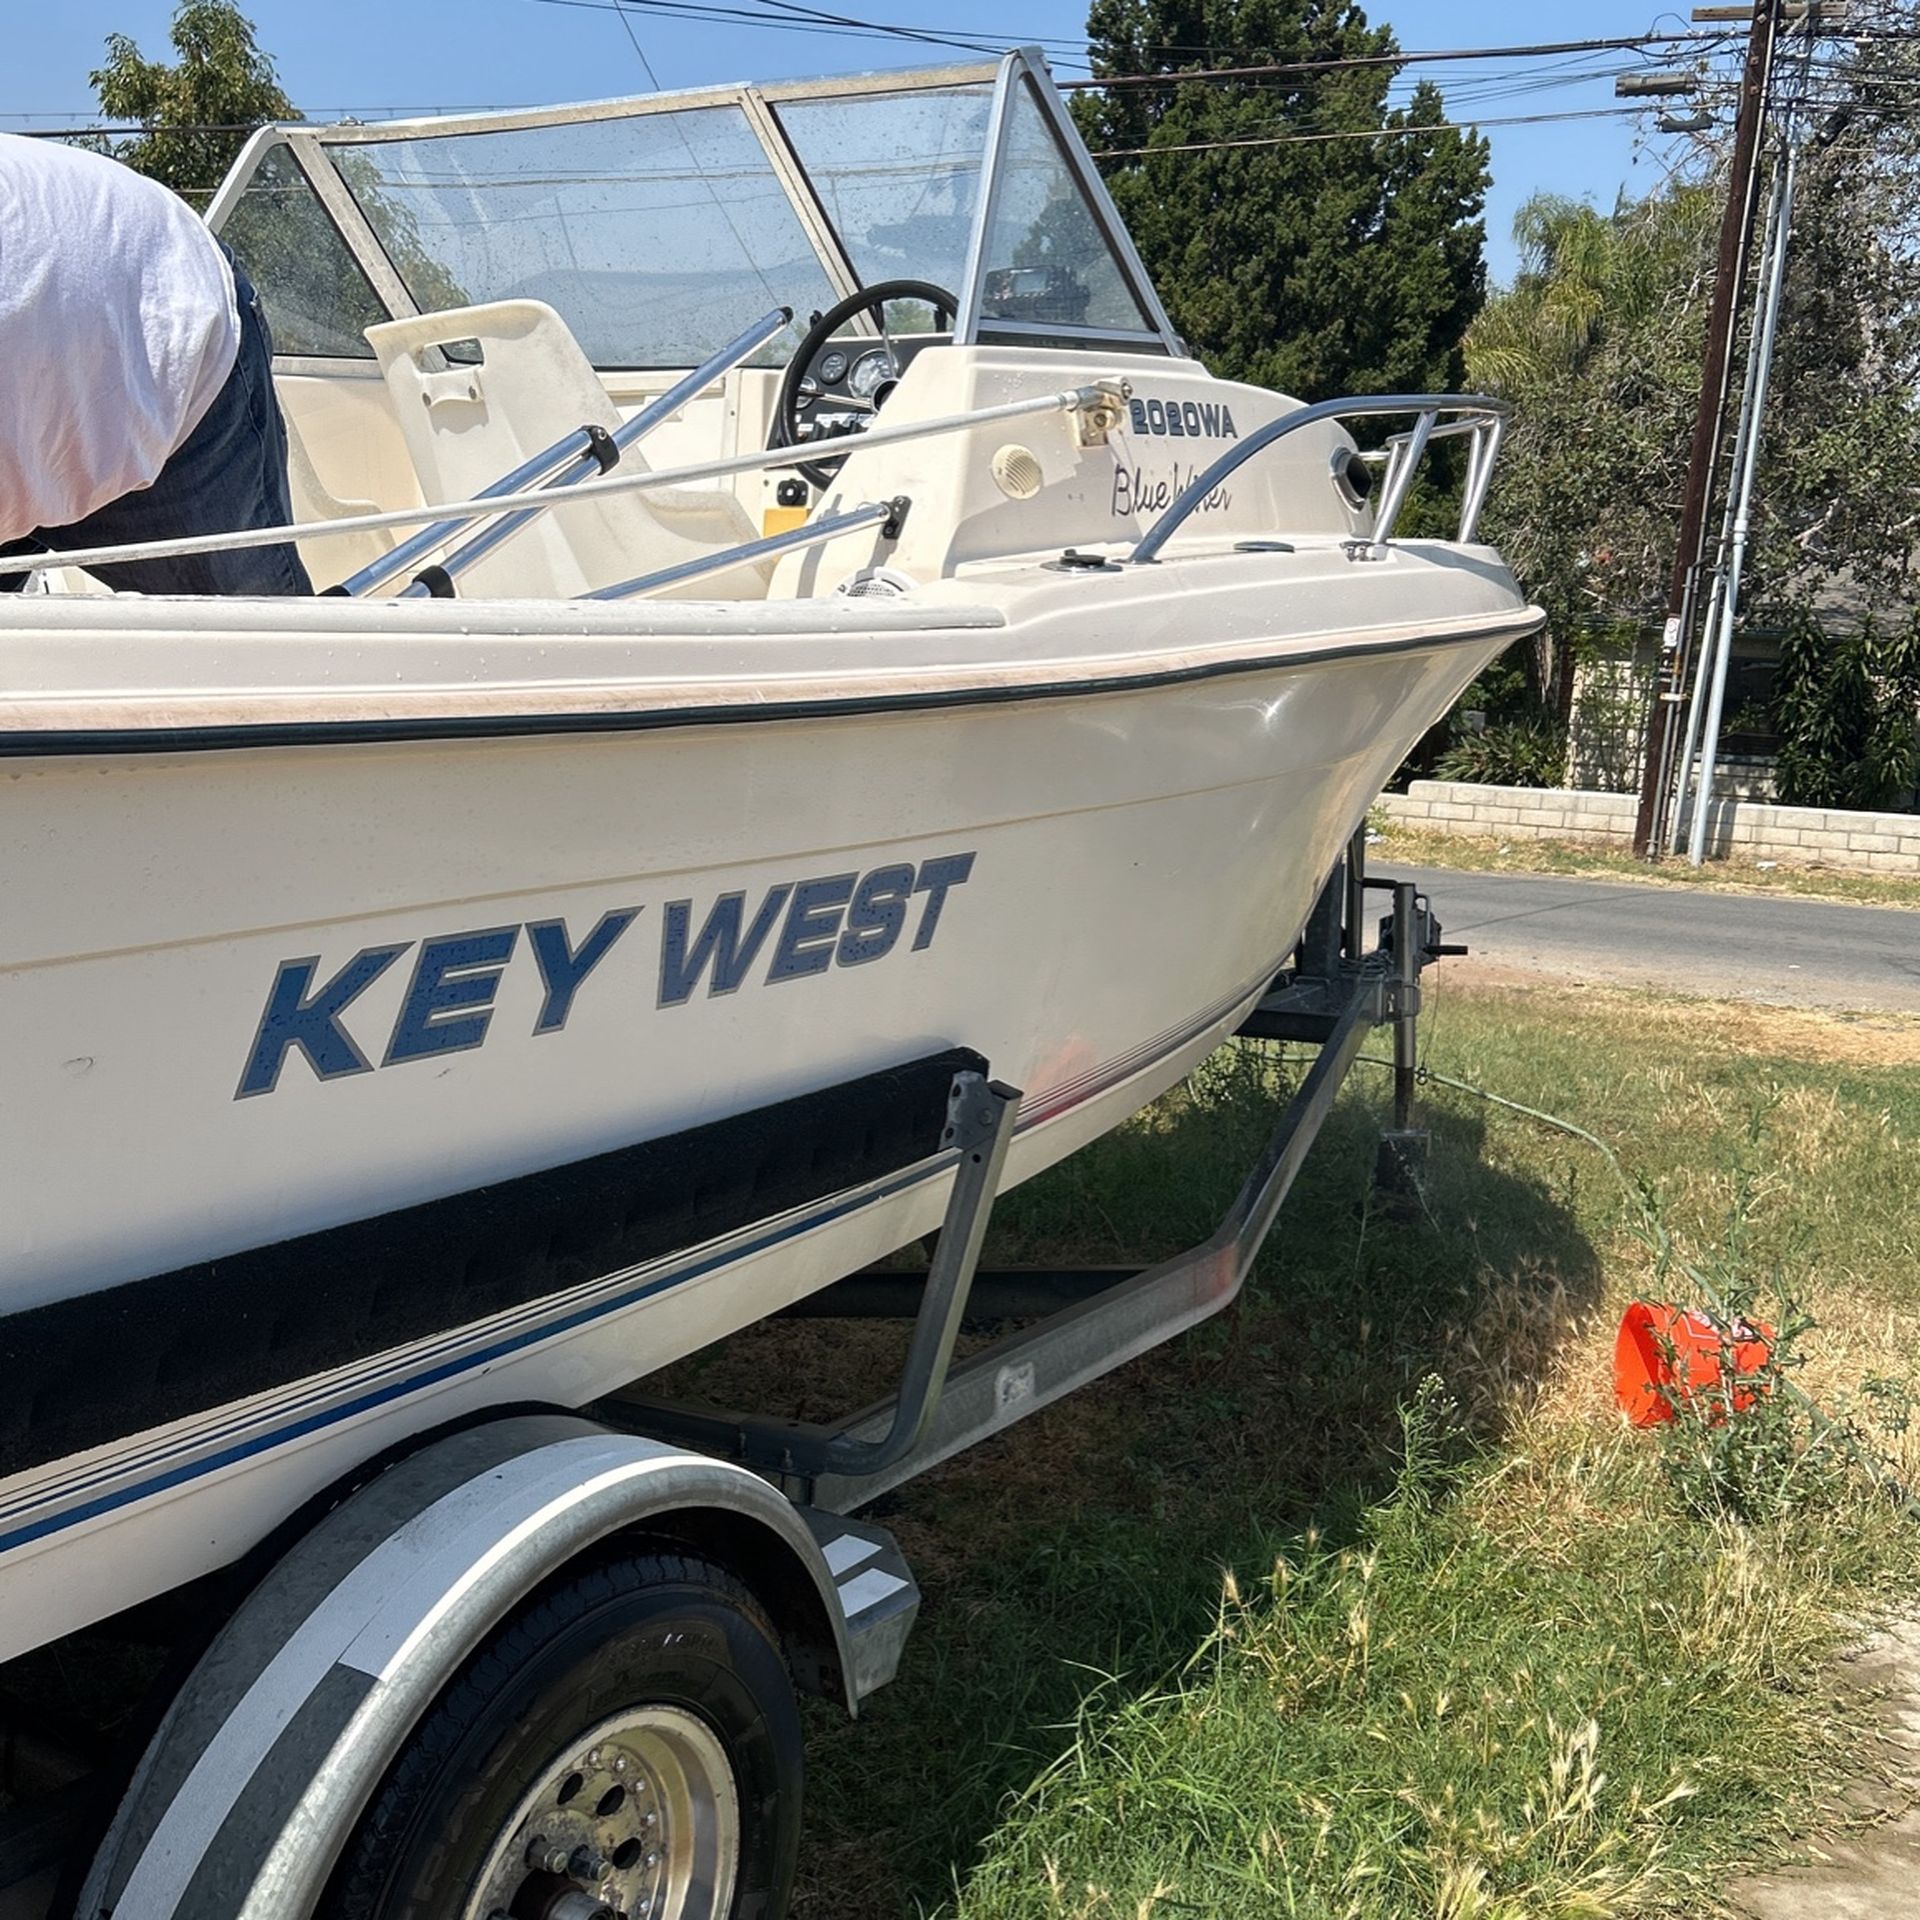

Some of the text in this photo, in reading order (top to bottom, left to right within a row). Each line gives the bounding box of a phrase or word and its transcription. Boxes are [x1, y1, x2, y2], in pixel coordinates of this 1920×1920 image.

[1129, 398, 1238, 438] 2020WA
[233, 851, 977, 1101] KEY WEST
